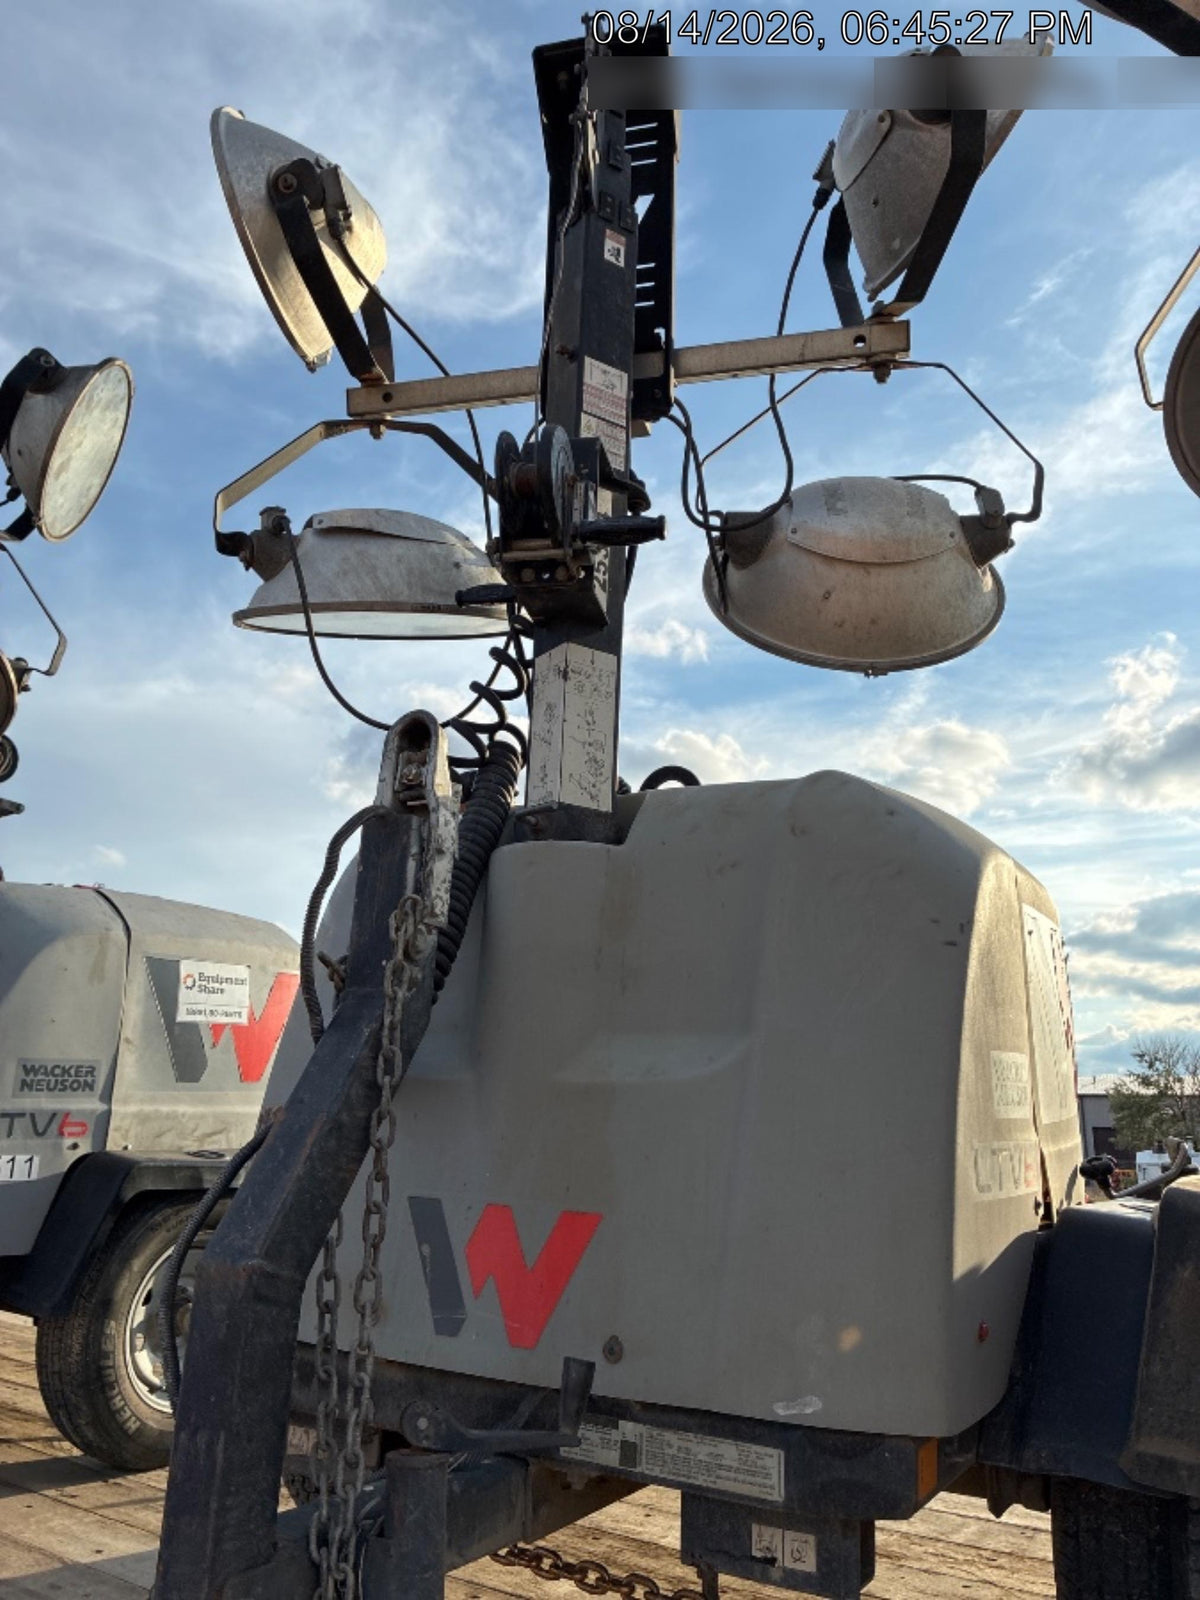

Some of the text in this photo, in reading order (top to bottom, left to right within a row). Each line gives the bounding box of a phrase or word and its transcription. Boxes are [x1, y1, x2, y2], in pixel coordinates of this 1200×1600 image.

[197, 984, 225, 995] Share
[22, 1064, 97, 1078] WACKER
[20, 1078, 96, 1092] NEUSON
[0, 1155, 34, 1179] 11
[101, 1319, 141, 1436] HERCULES
